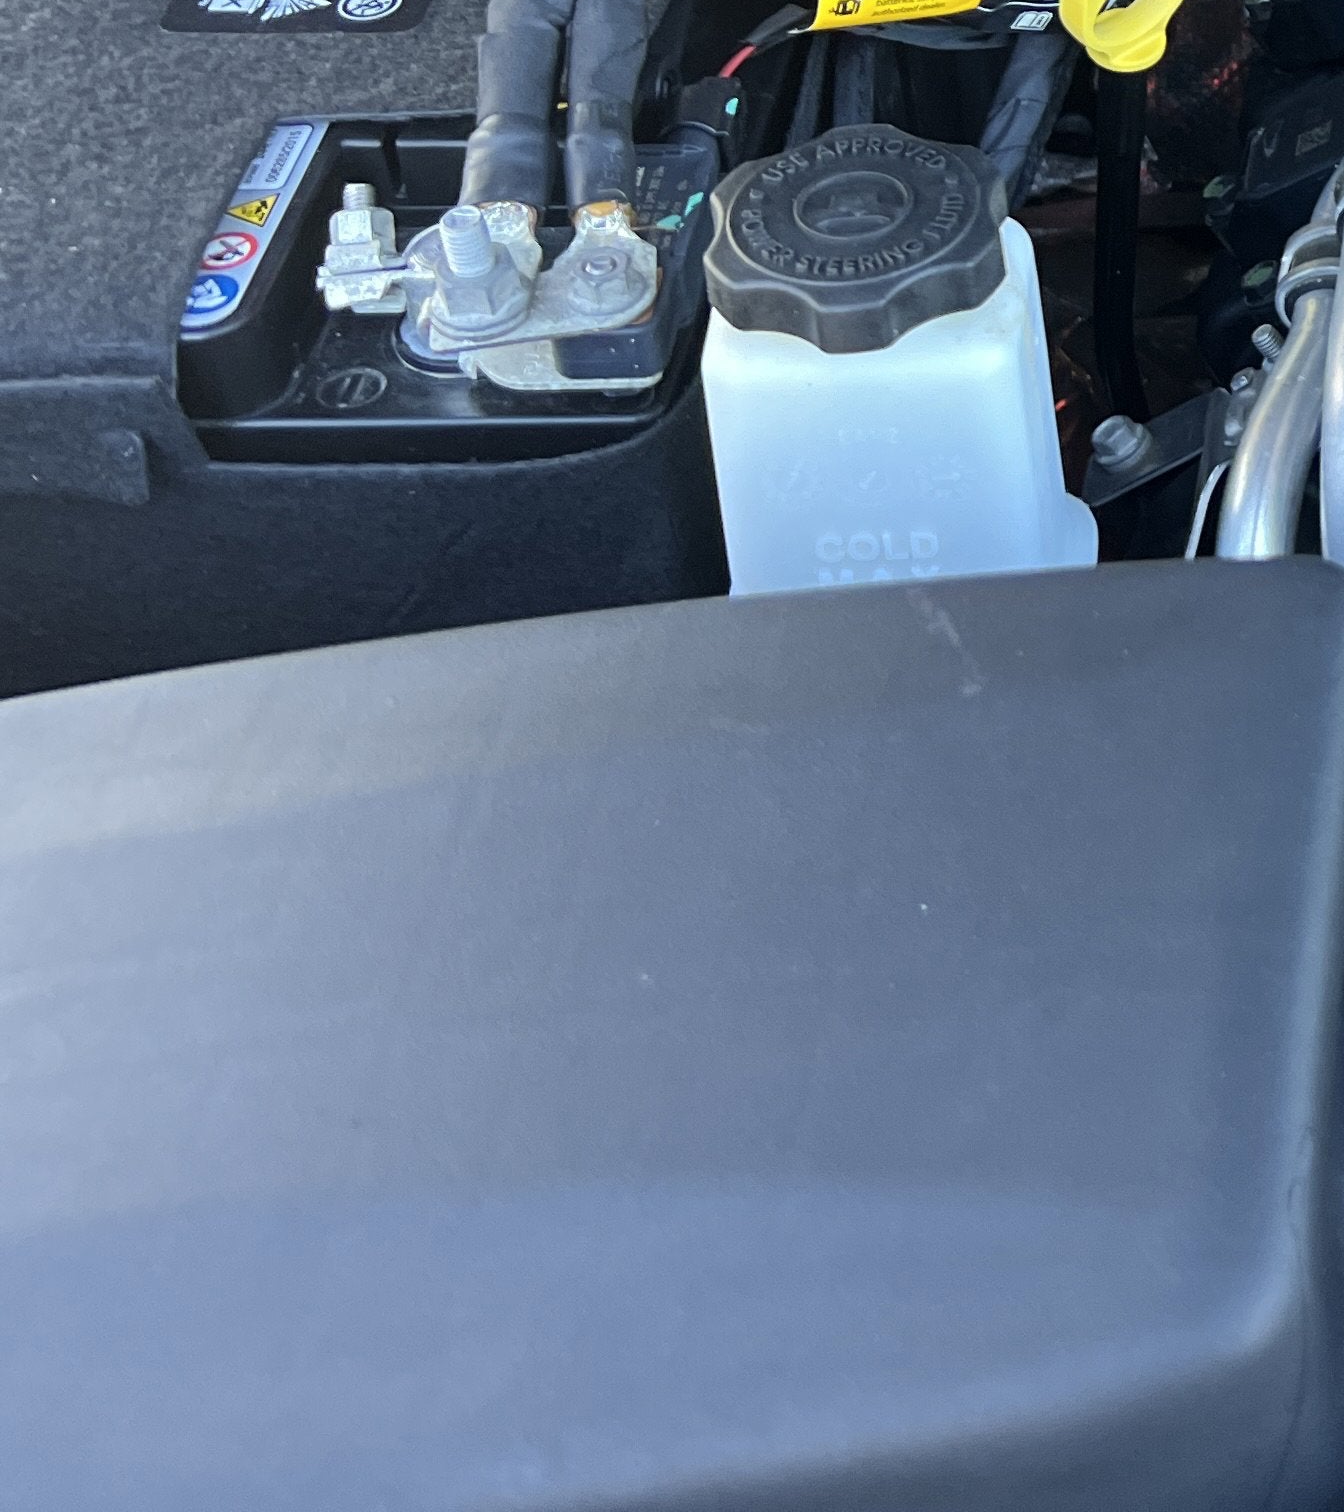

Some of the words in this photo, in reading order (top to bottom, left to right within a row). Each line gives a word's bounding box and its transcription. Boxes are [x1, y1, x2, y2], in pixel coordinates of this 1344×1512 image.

[761, 151, 809, 183] USE
[815, 138, 946, 169] APPROVED
[795, 238, 925, 275] STEERING
[814, 530, 941, 564] COLD
